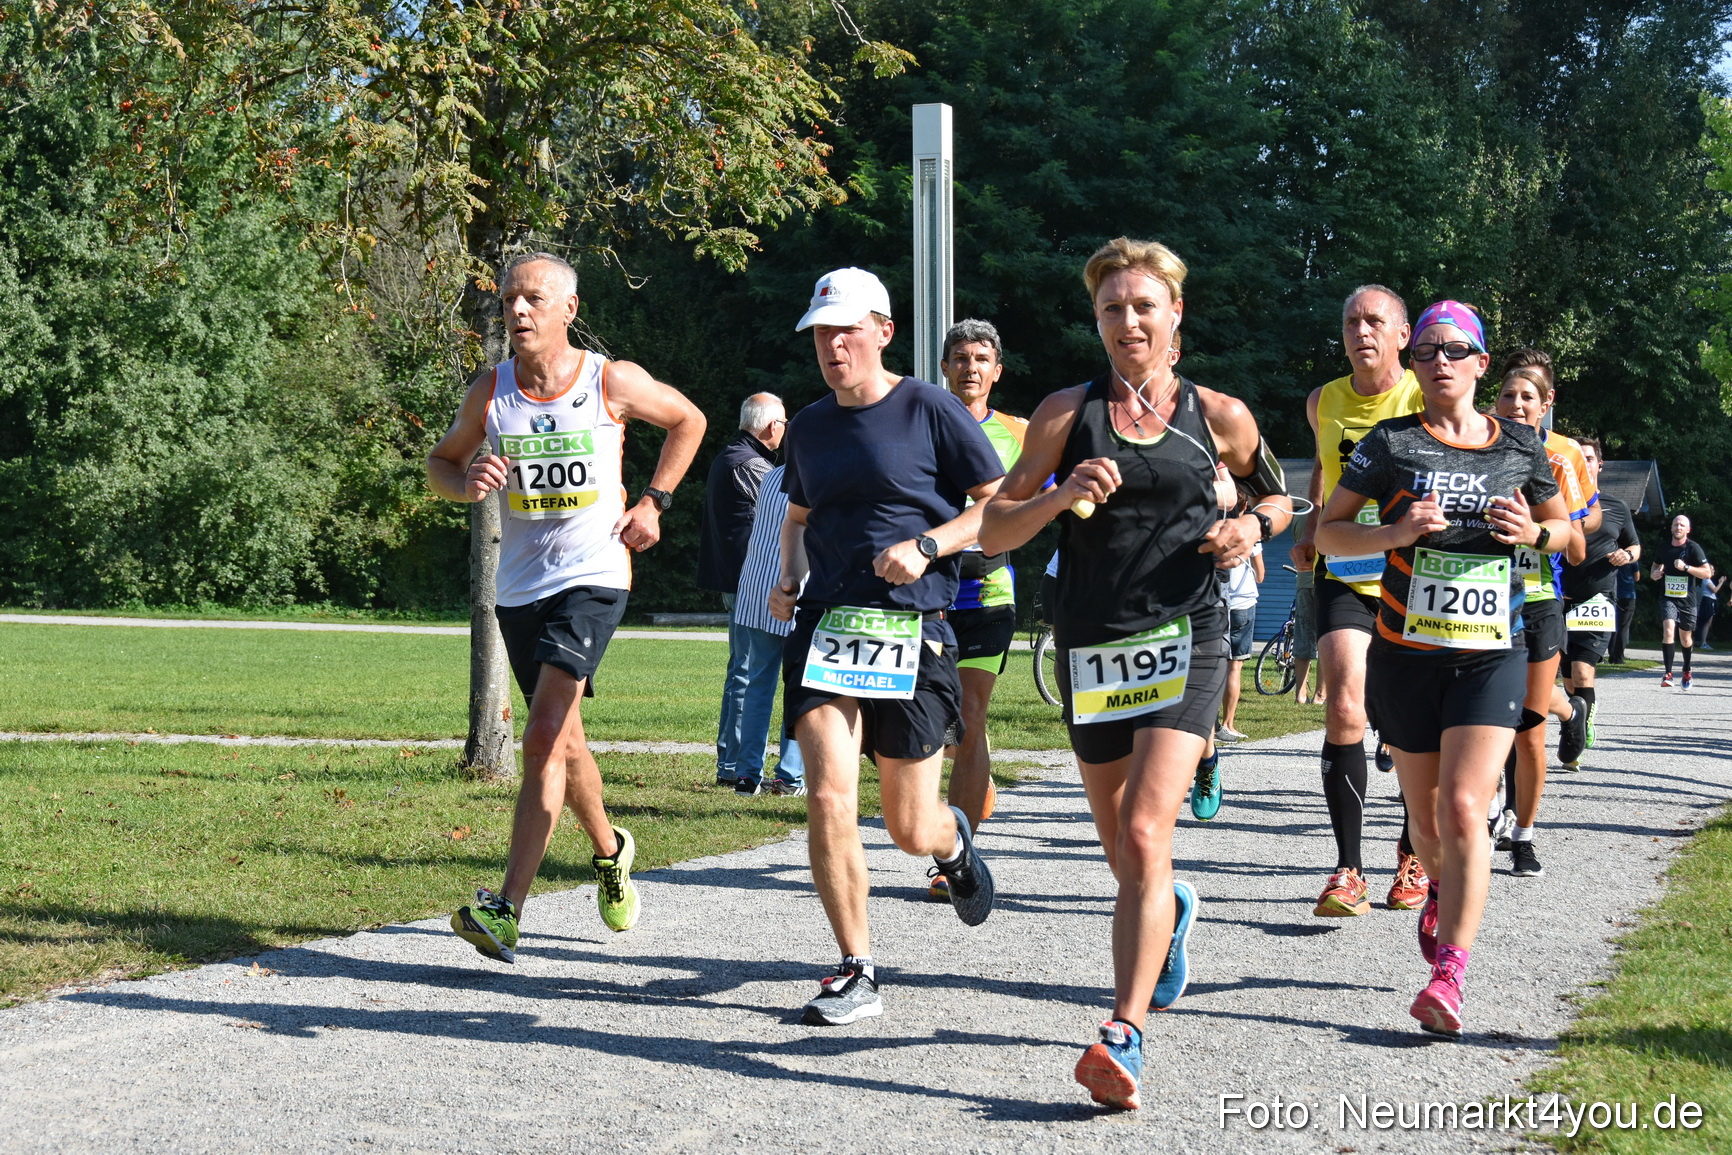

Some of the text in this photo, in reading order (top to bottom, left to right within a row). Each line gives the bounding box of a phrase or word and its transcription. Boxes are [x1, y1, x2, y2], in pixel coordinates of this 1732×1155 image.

[503, 434, 586, 456] BOCK
[511, 461, 587, 490] 1200
[1412, 471, 1488, 493] HECK
[522, 496, 578, 510] STEFAN
[1423, 556, 1499, 577] BOCK
[1667, 583, 1685, 591] 1229
[1423, 584, 1498, 616] 1208
[1573, 605, 1608, 618] 1261
[827, 612, 908, 634] BOCK
[1416, 618, 1497, 634] ANN-CHRISTIN
[822, 637, 904, 669] 2171
[1086, 645, 1179, 684] 1195
[823, 671, 897, 689] MICHAEL
[1106, 688, 1159, 708] MARIA
